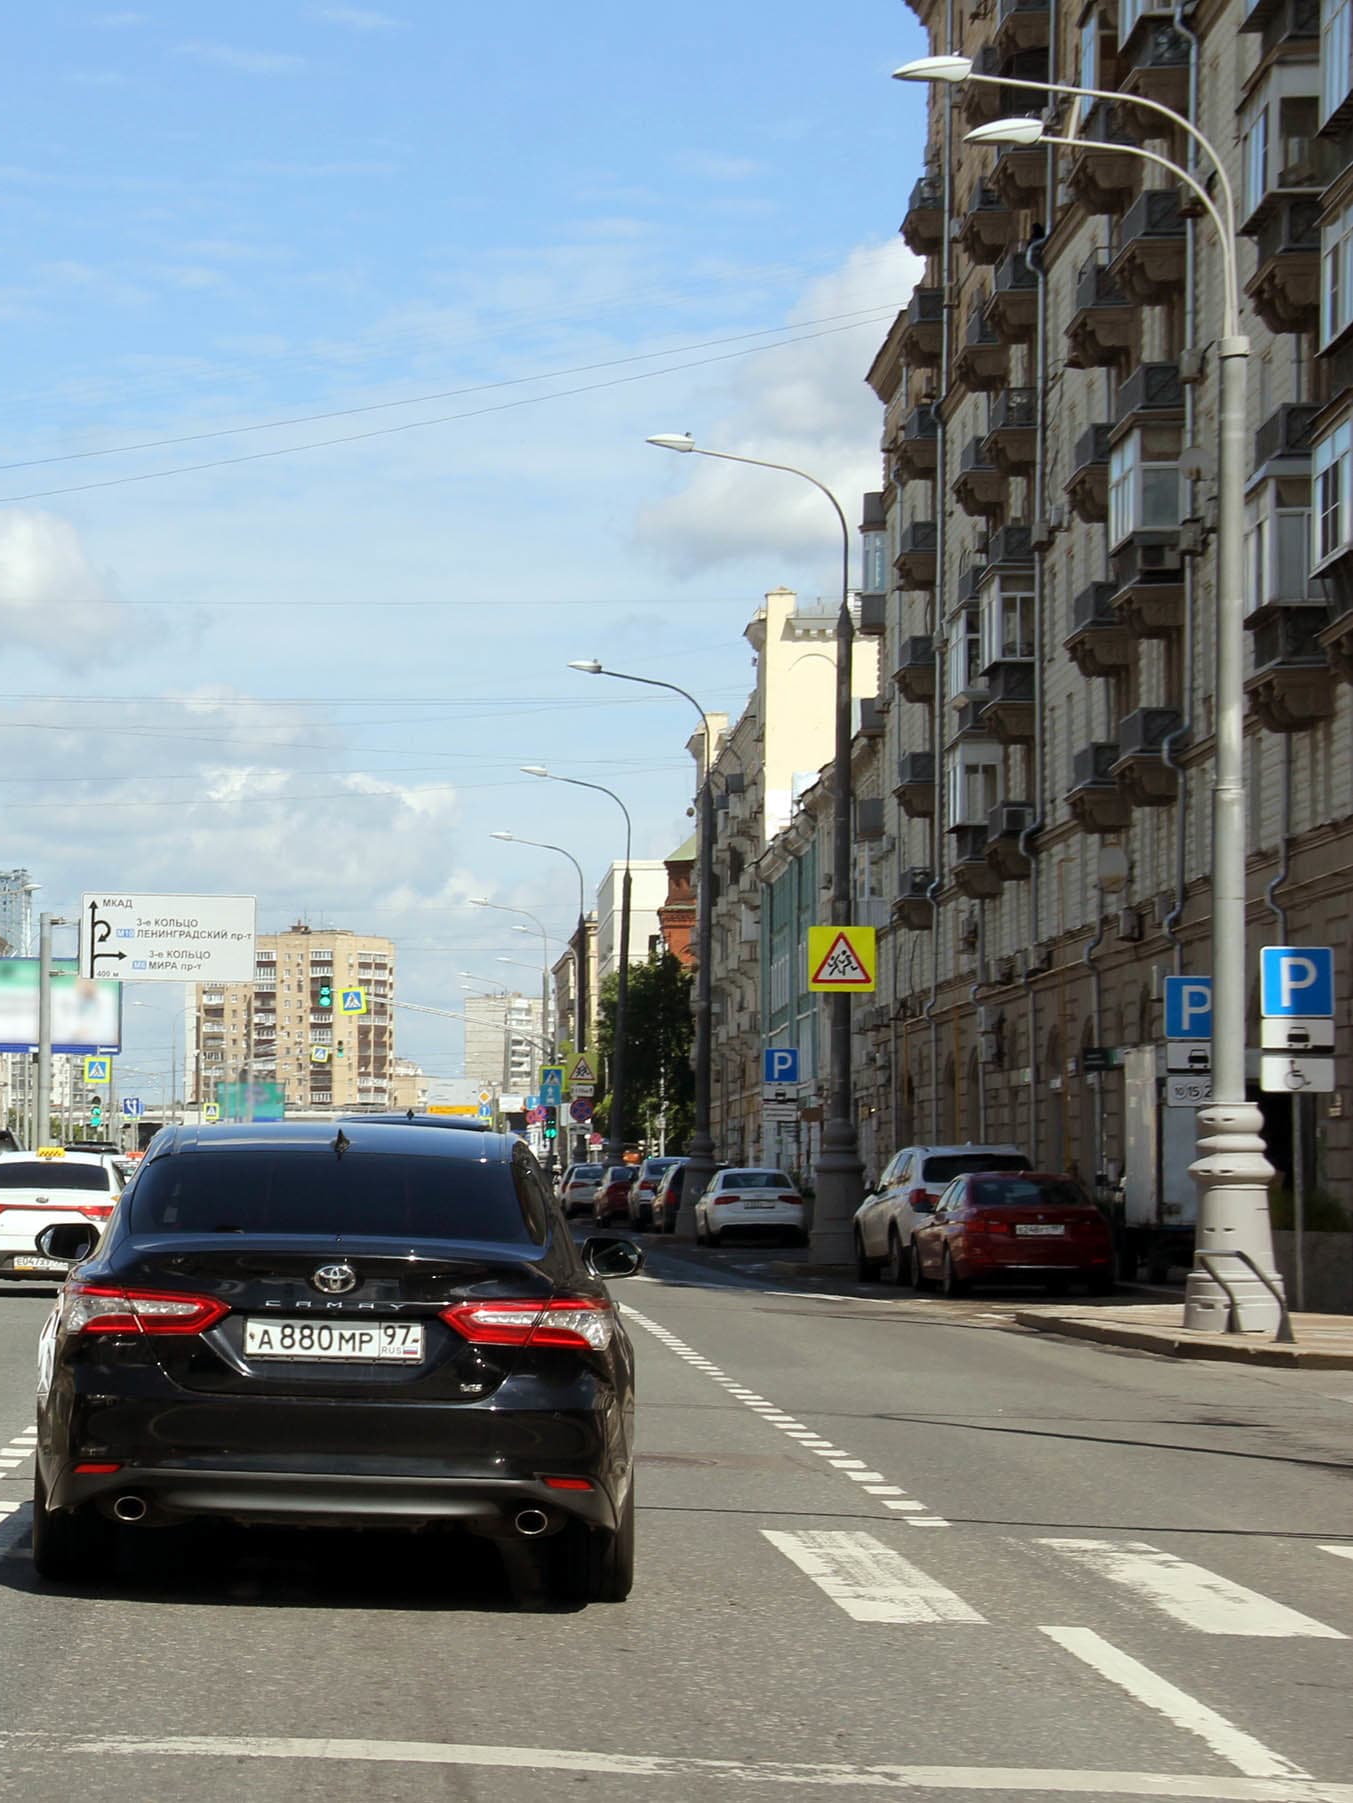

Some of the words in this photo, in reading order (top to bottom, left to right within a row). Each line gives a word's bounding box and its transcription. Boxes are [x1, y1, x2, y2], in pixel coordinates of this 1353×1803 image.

[102, 899, 133, 909] МКАД
[154, 918, 199, 928] КОЛЬЦО
[136, 928, 228, 940] ЛЕНИНГРАДСКИЙ
[231, 932, 252, 941] пр-т
[167, 950, 211, 960] КОЛЬЦО
[149, 961, 178, 970] МИРА
[180, 963, 202, 971] пр-т
[1280, 957, 1317, 1008] P
[383, 1325, 412, 1346] 97
